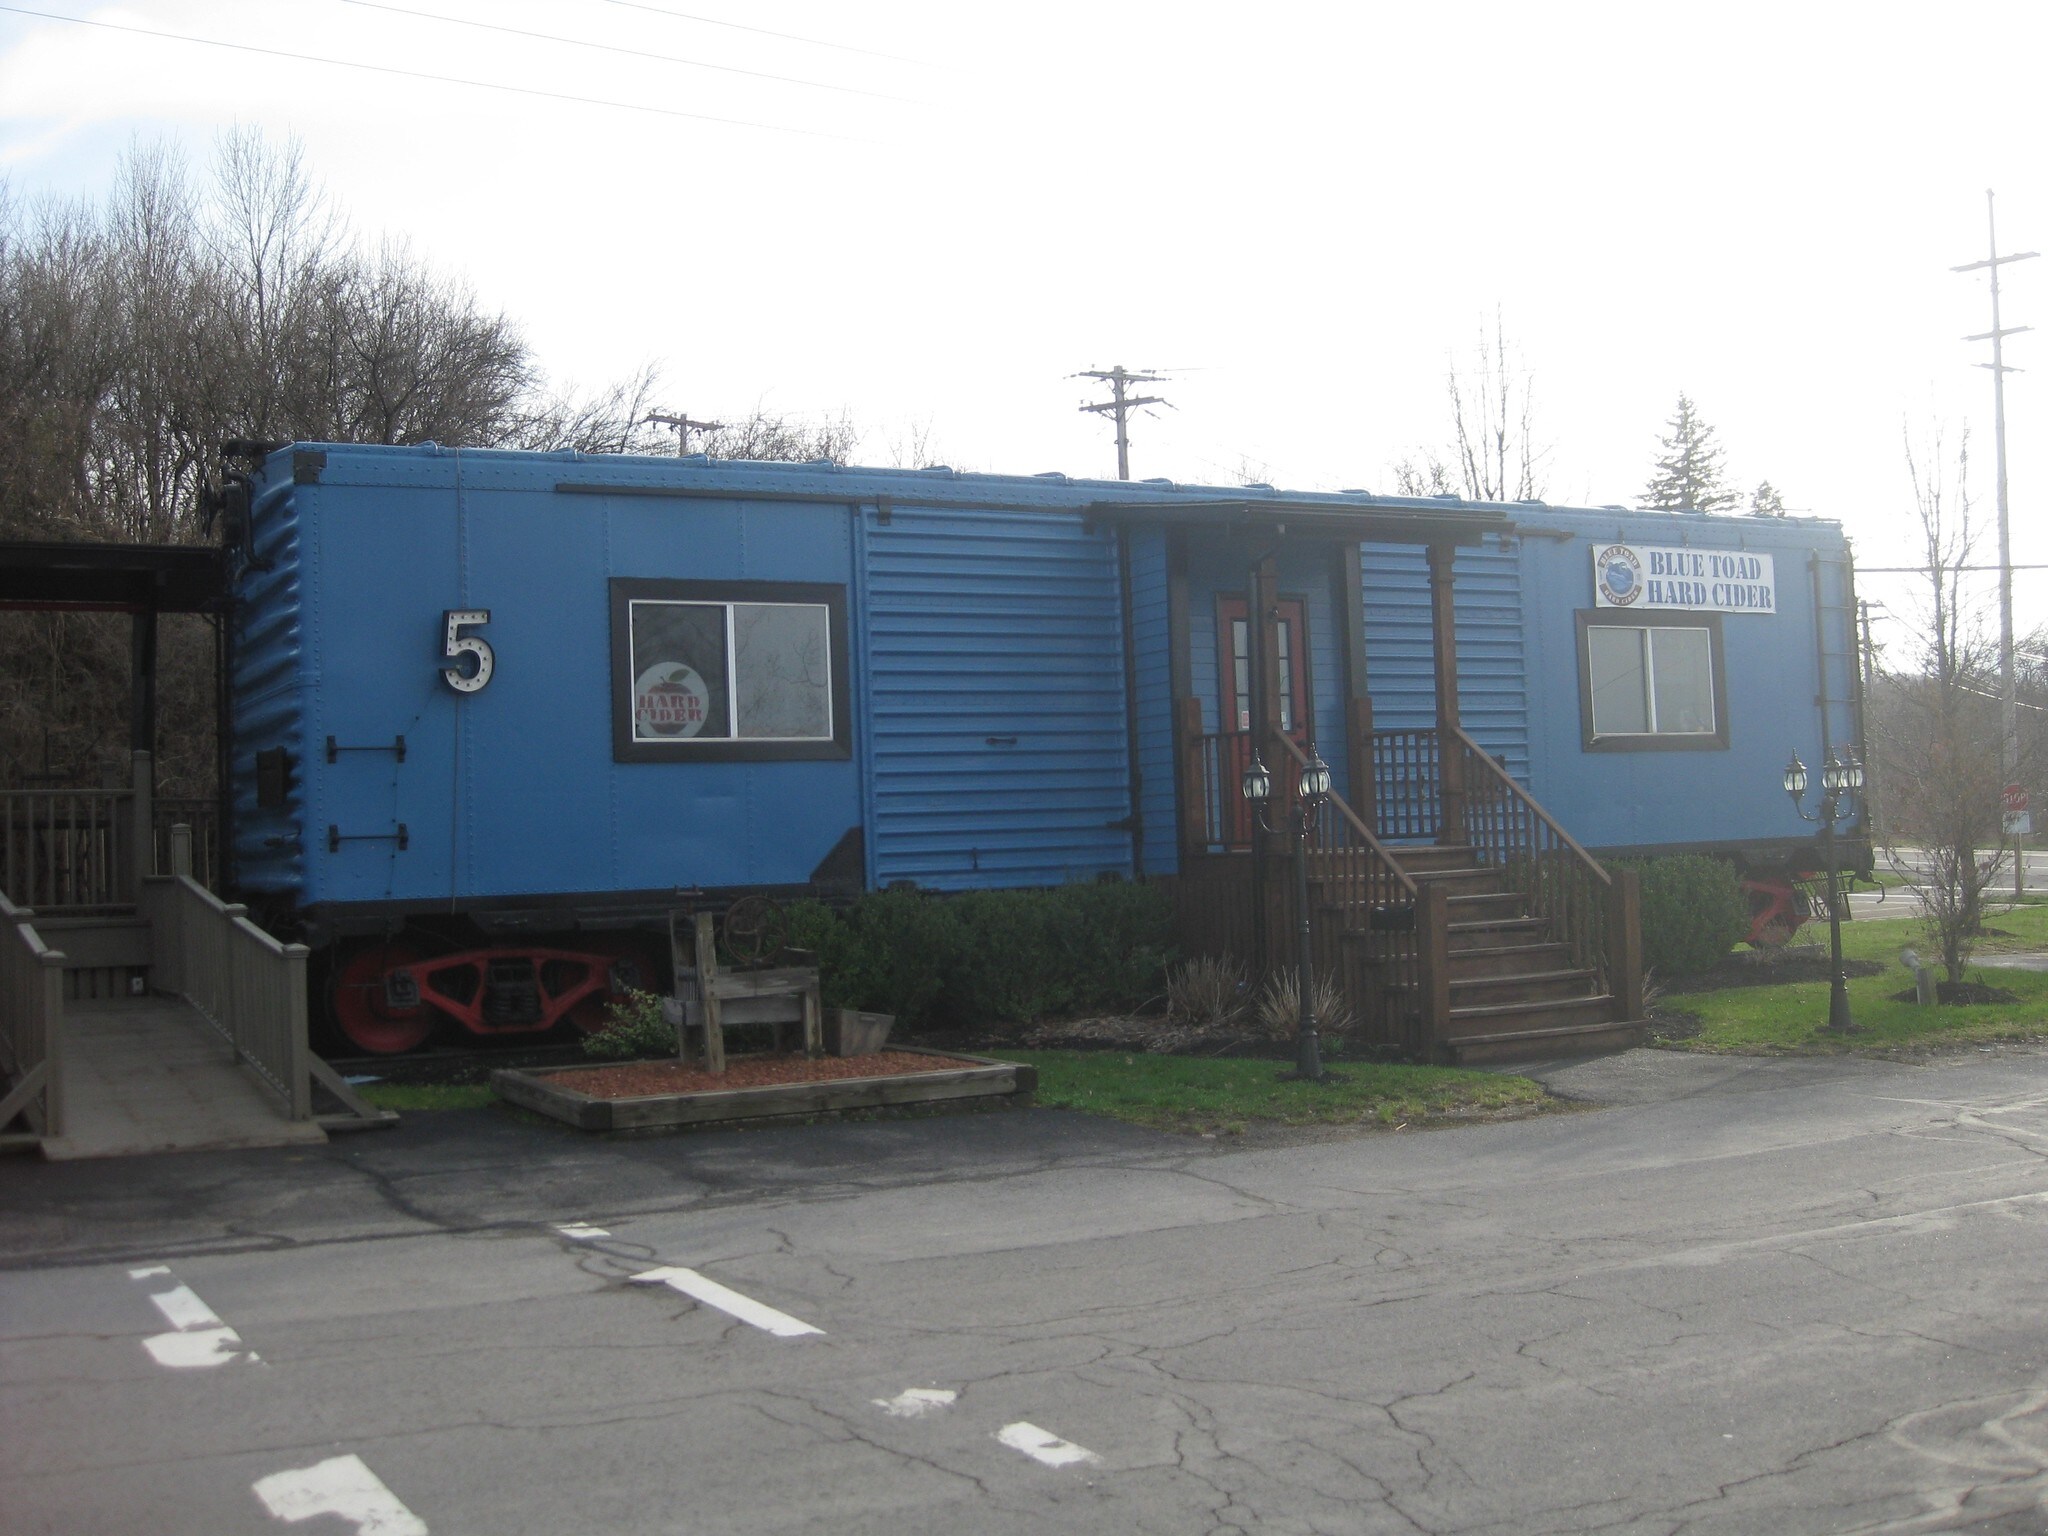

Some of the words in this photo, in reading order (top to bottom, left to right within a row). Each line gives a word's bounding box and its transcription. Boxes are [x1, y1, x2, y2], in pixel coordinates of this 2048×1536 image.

[1649, 551, 1704, 577] BLUE
[1709, 555, 1761, 580] TOAD
[1647, 580, 1707, 605] HARD
[1712, 583, 1772, 609] CIDER
[441, 609, 495, 693] 5
[639, 695, 701, 708] HARD
[636, 709, 702, 721] CIDER
[2003, 792, 2026, 803] STOP
